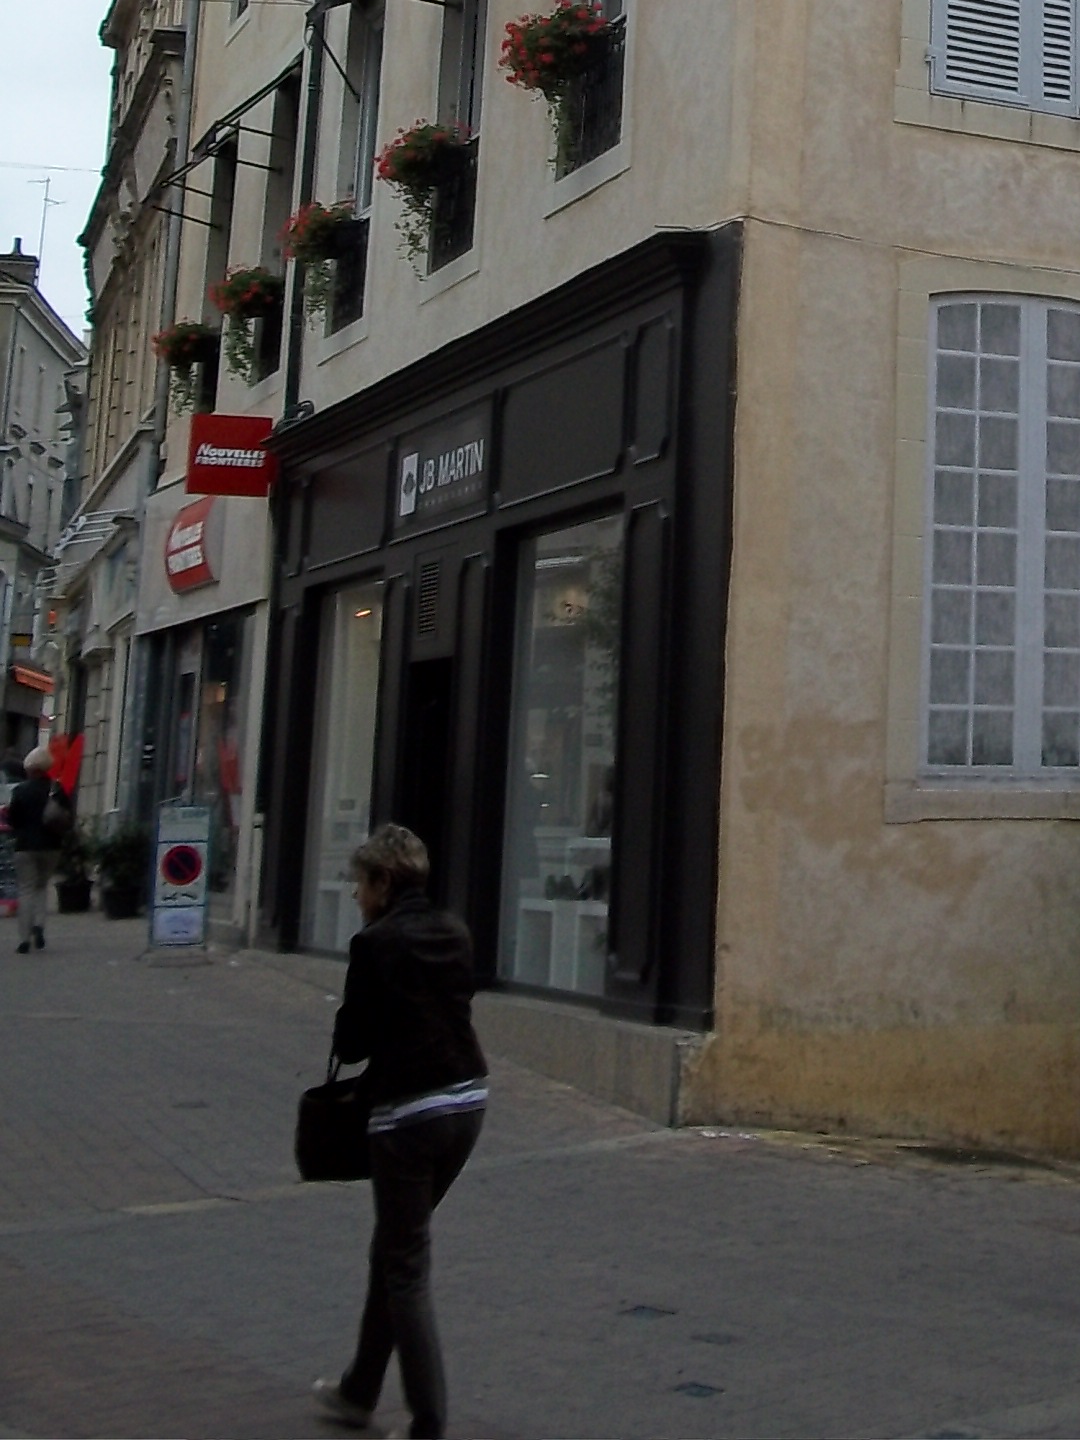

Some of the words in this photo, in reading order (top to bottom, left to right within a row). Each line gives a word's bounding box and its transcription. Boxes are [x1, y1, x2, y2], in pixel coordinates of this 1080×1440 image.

[196, 442, 267, 459] NOUVELLES
[419, 459, 435, 494] JB
[437, 439, 485, 487] MARTIN
